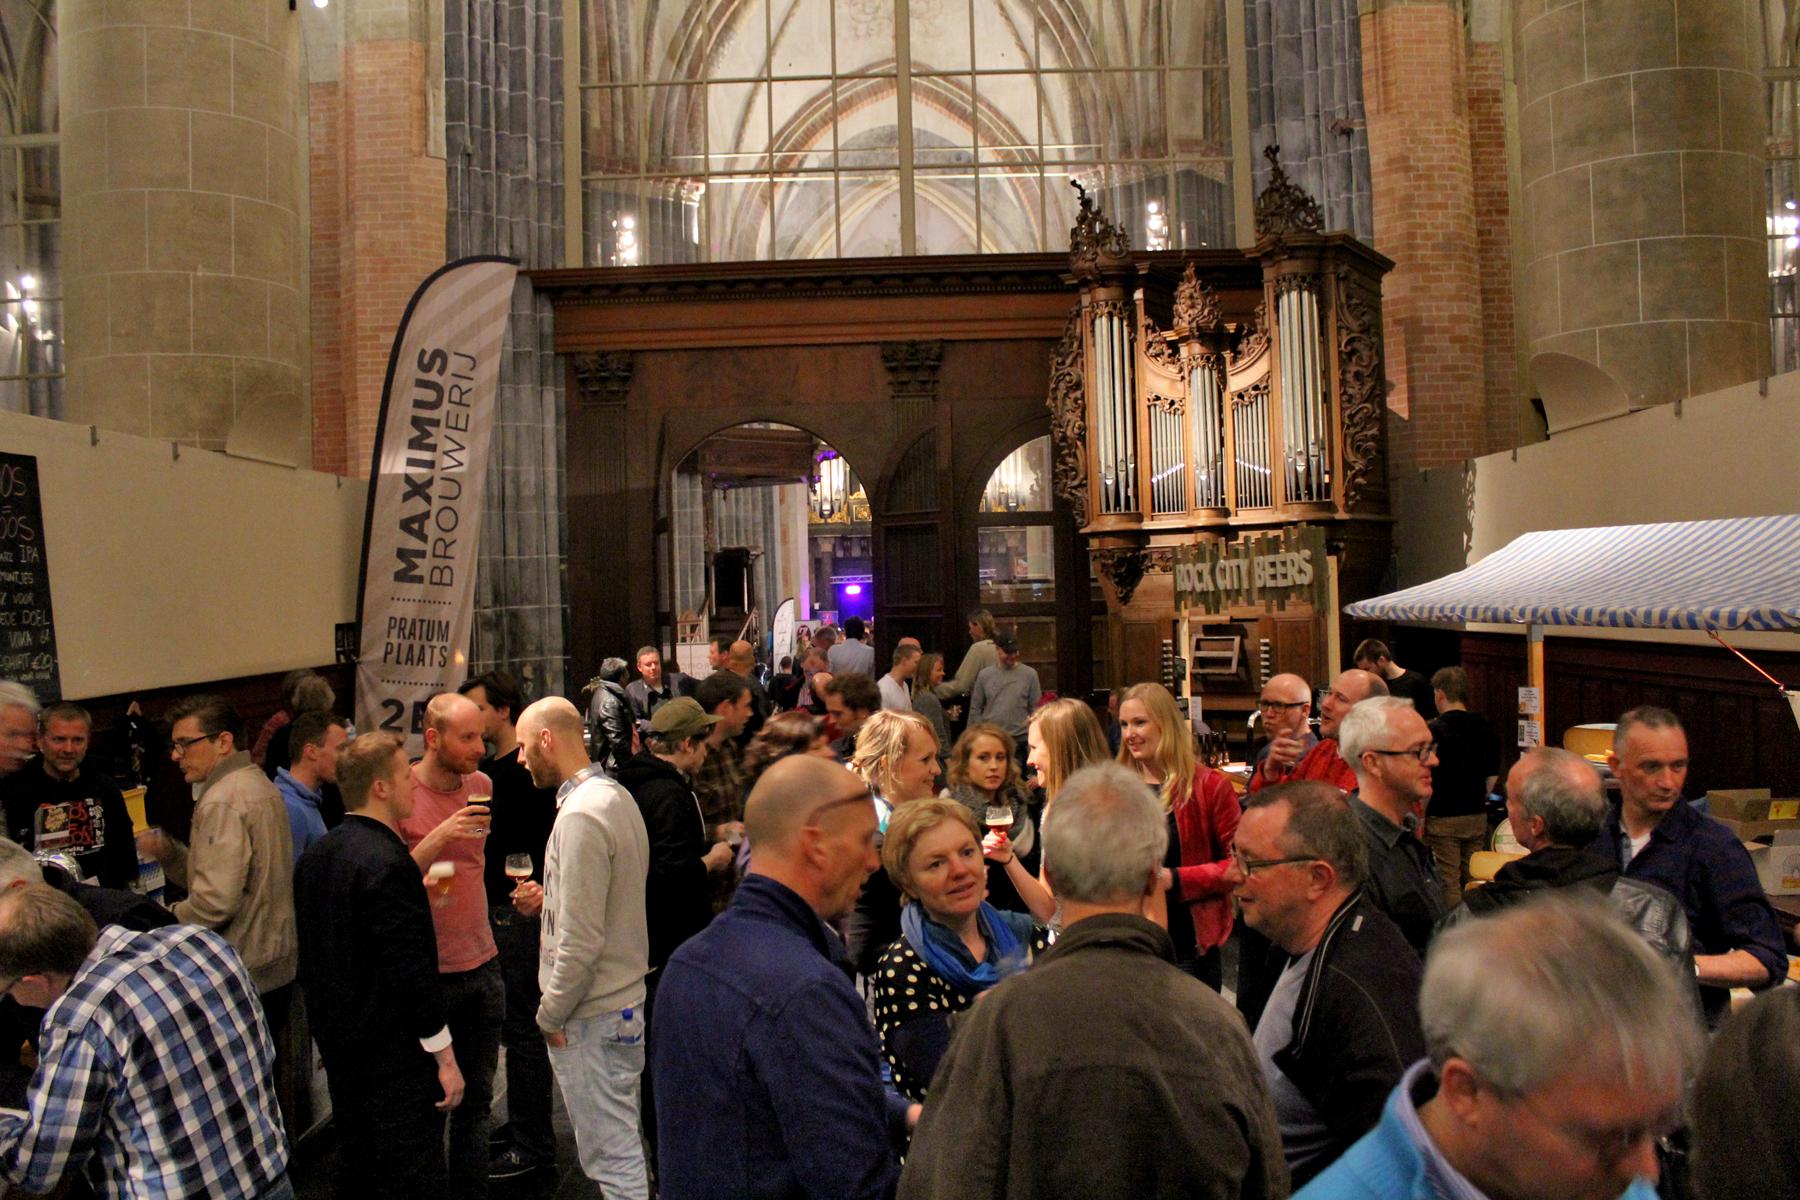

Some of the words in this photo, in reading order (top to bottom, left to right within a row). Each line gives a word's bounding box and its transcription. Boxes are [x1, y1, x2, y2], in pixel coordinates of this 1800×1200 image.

[393, 348, 448, 585] MAXIMUS
[429, 351, 477, 587] BROUWERIJ
[1175, 563, 1215, 592] ROCK
[1215, 558, 1252, 590] CITY
[1253, 549, 1314, 588] BEERS
[386, 616, 450, 642] PRATUM
[383, 641, 449, 668] PLAATS
